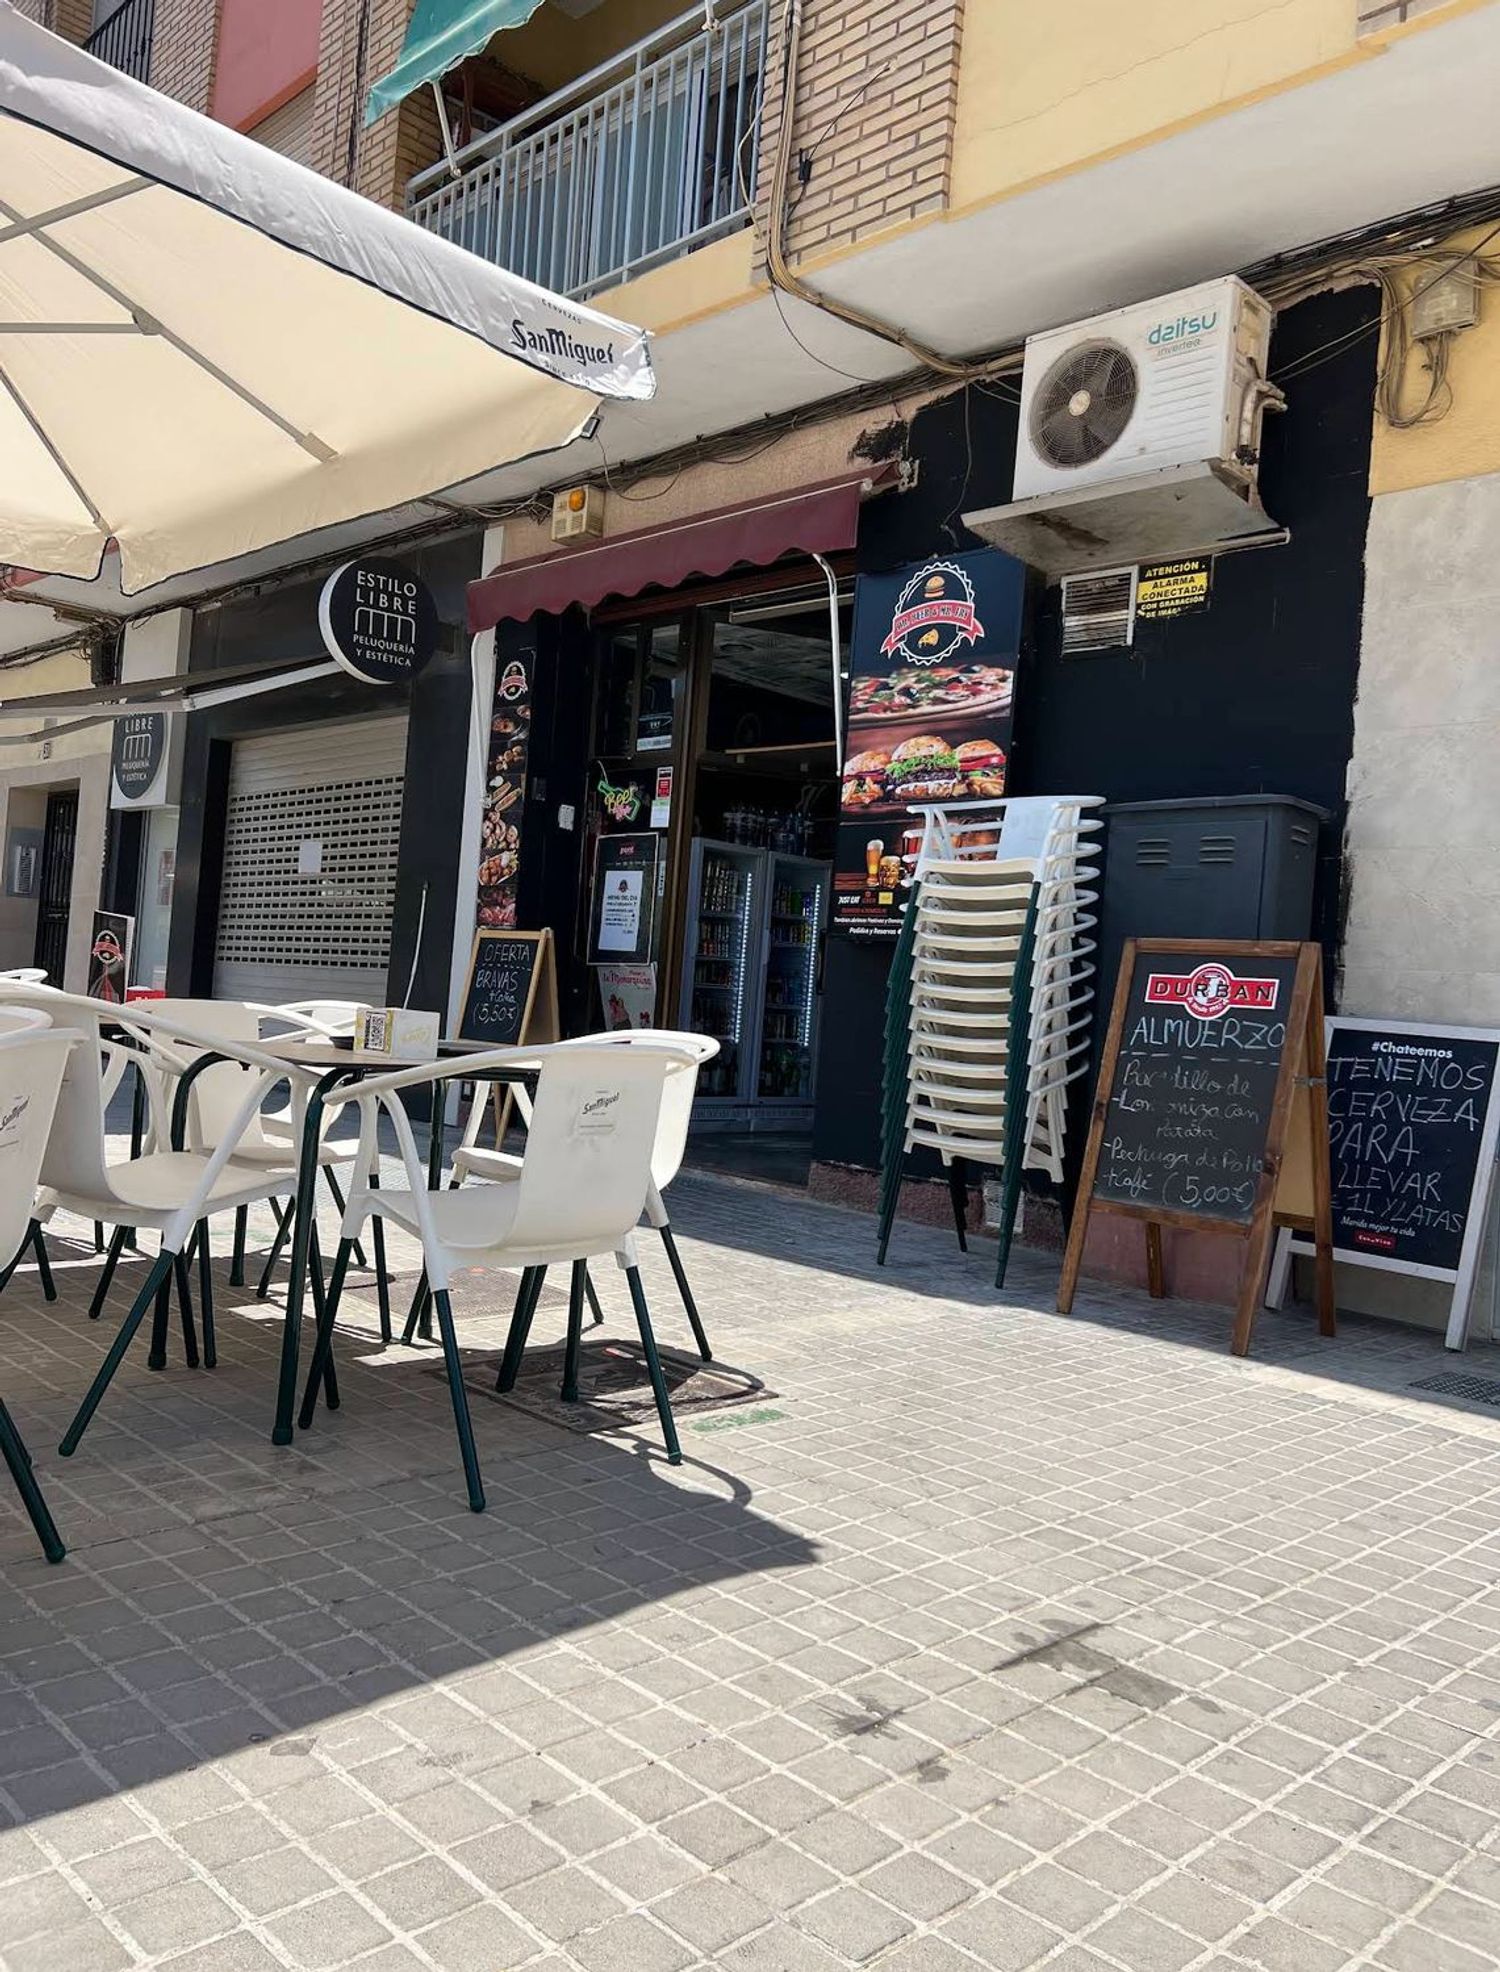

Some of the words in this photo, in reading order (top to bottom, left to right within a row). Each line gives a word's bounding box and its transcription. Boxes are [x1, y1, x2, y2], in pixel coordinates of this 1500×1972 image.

[1144, 561, 1200, 578] ATENCIÓN
[357, 570, 417, 597] ESTILO
[1141, 584, 1206, 601] CONECTADA
[1151, 575, 1196, 590] ALARMA
[356, 587, 417, 615] LIBRE
[1141, 602, 1158, 611] CON
[353, 633, 416, 655] PELUQUERÍA
[355, 648, 363, 657] Y
[365, 650, 412, 667] ESTÉTICA
[124, 716, 154, 733] LIBRE
[484, 943, 530, 963] OFERTA
[475, 969, 518, 992] BRAVAS
[1153, 980, 1273, 1000] DURBAN
[1130, 1015, 1286, 1051] ALMUERZO
[1371, 1041, 1453, 1059] #Chateemos
[1327, 1056, 1486, 1090] TENEMOS
[1327, 1088, 1480, 1132] CERVEZA
[1337, 1162, 1441, 1202] LLEVAR
